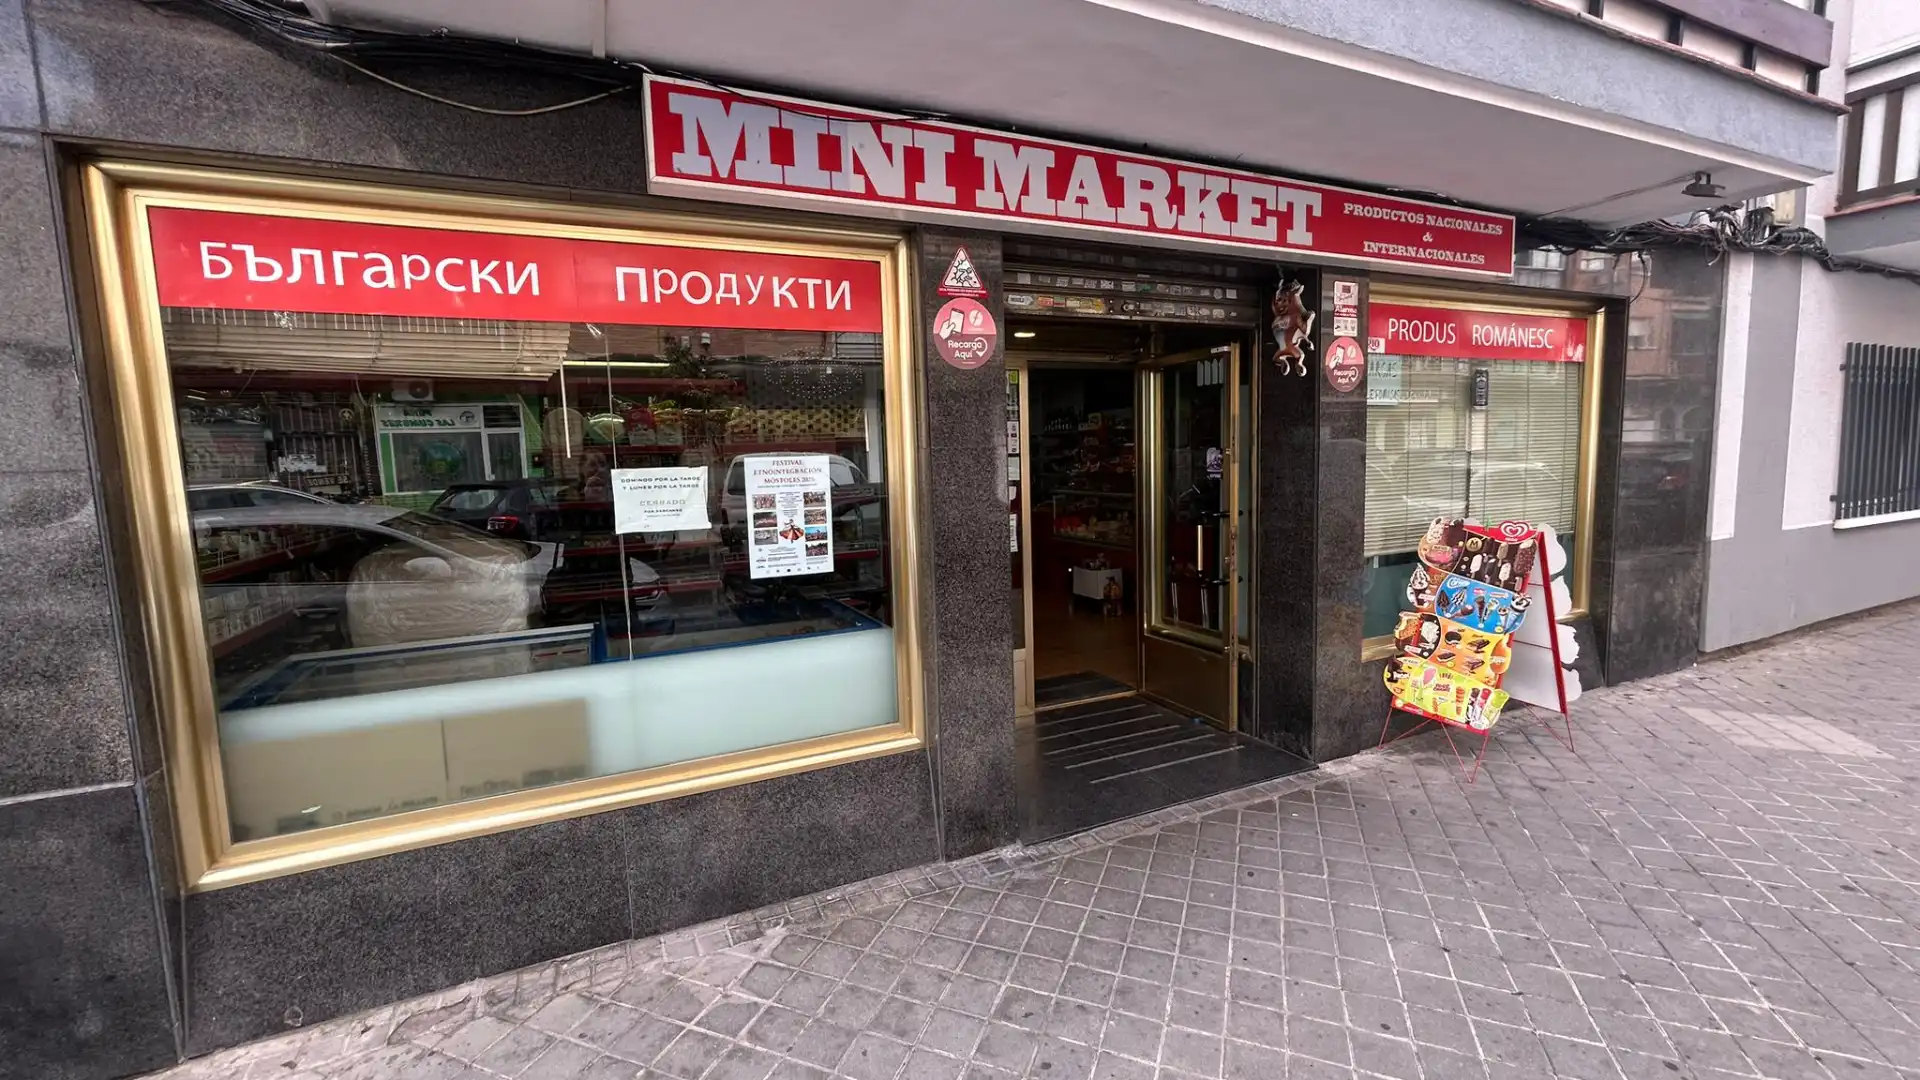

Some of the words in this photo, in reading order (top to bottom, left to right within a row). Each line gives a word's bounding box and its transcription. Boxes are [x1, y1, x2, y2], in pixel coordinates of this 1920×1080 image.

[668, 92, 956, 204] MINI
[974, 138, 1322, 246] MARKET
[1343, 202, 1425, 225] PRODUCTOS
[1426, 215, 1503, 235] NACIONALES
[1422, 232, 1434, 243] &
[1363, 241, 1485, 265] INTERNACIONALES
[1387, 317, 1456, 345] PRODUS
[1472, 322, 1554, 349] ROMÁNESC
[947, 339, 982, 351] Recarga
[954, 349, 973, 360] Aquí
[1333, 369, 1356, 377] Recarga
